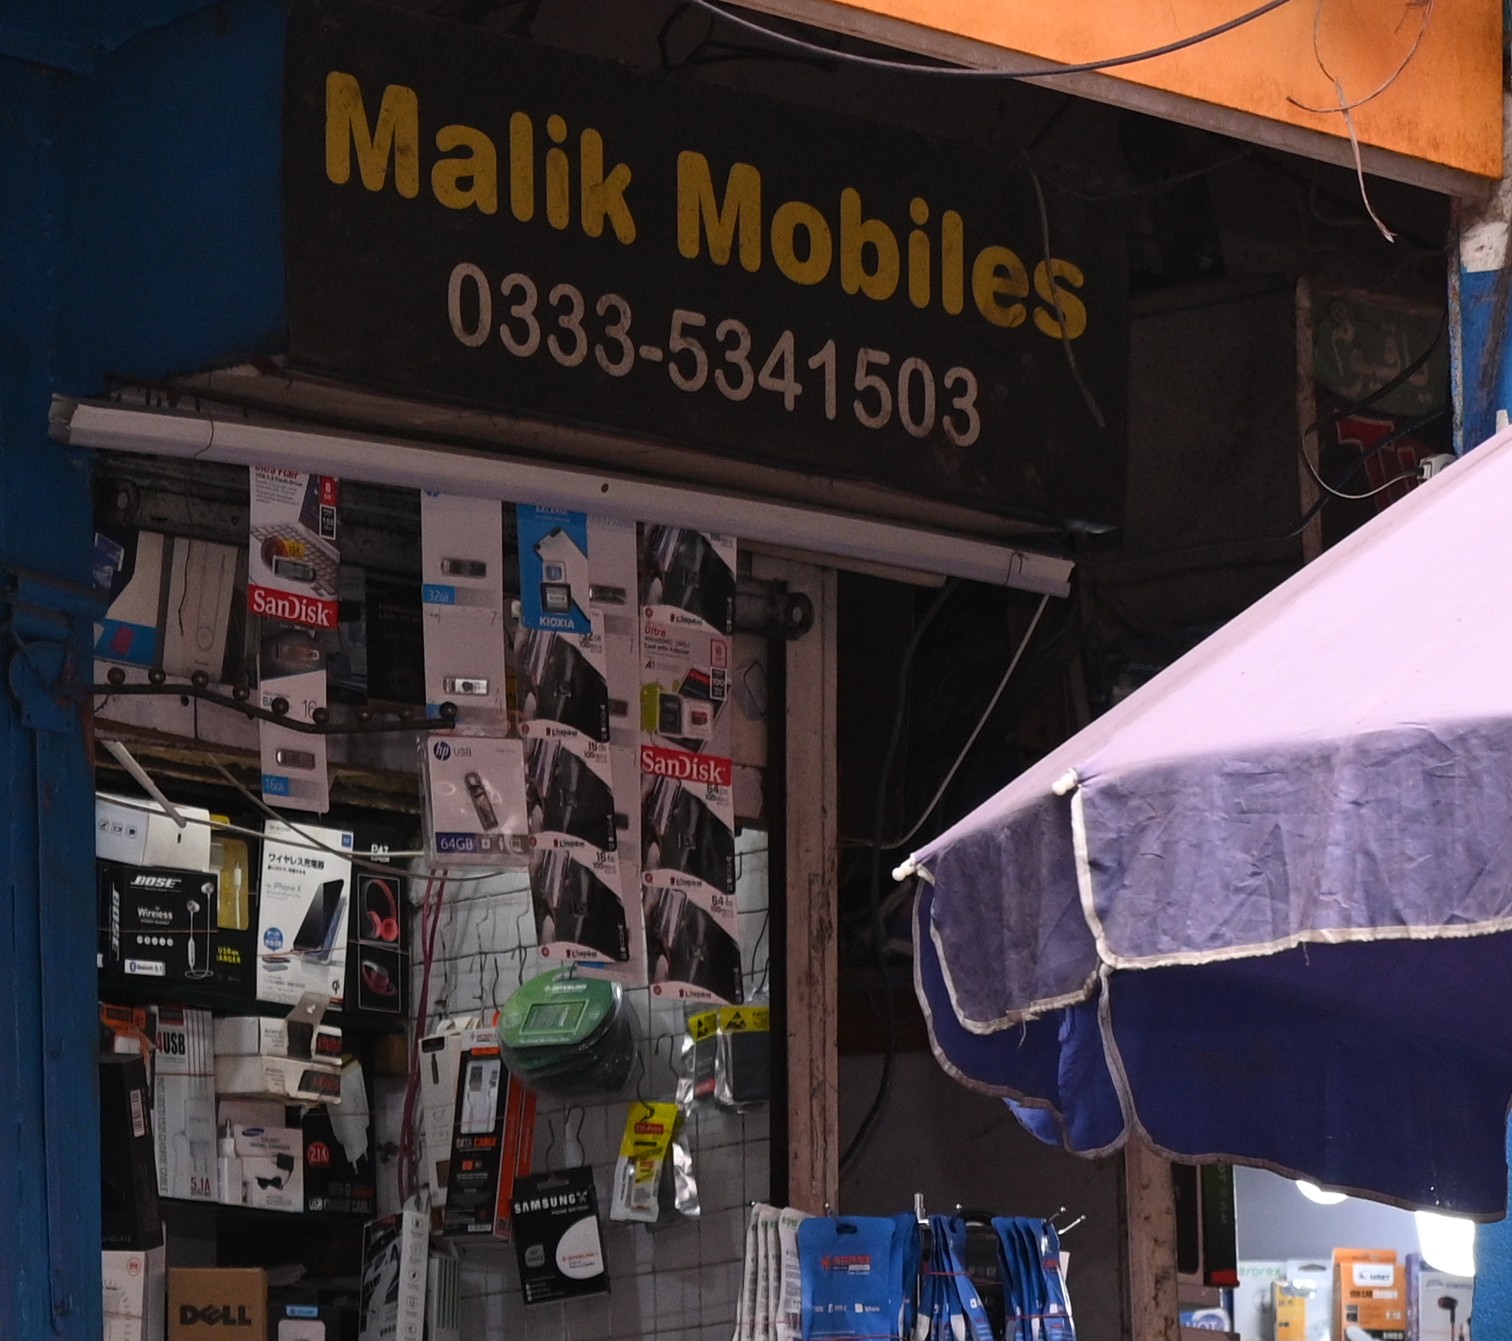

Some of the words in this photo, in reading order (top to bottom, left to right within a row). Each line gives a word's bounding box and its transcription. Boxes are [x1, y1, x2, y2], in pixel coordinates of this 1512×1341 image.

[323, 70, 638, 246] Malik
[677, 150, 1088, 341] Mobiles
[447, 261, 982, 448] 0333-5341503
[253, 590, 332, 626] SanDisk
[540, 617, 575, 629] KIOXIA
[642, 751, 725, 783] SanDisk
[441, 838, 473, 850] 64GB
[514, 1193, 576, 1215] SAMSUNG
[179, 1304, 253, 1326] DELL
